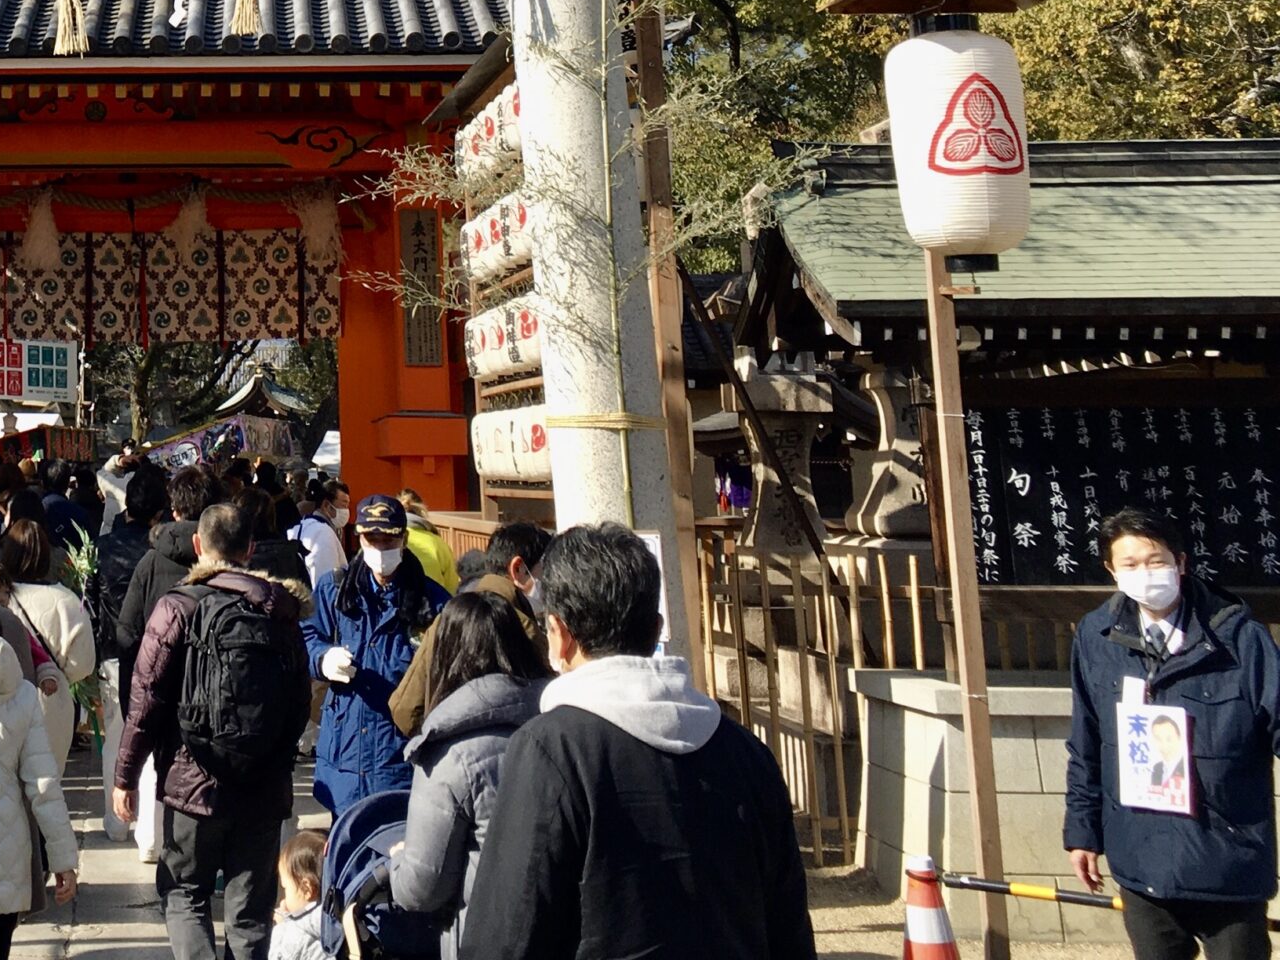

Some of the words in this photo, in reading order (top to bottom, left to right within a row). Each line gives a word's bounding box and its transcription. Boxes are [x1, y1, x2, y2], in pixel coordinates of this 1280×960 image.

[1007, 467, 1041, 548] 旬祭
[1217, 471, 1249, 564] 元始祭
